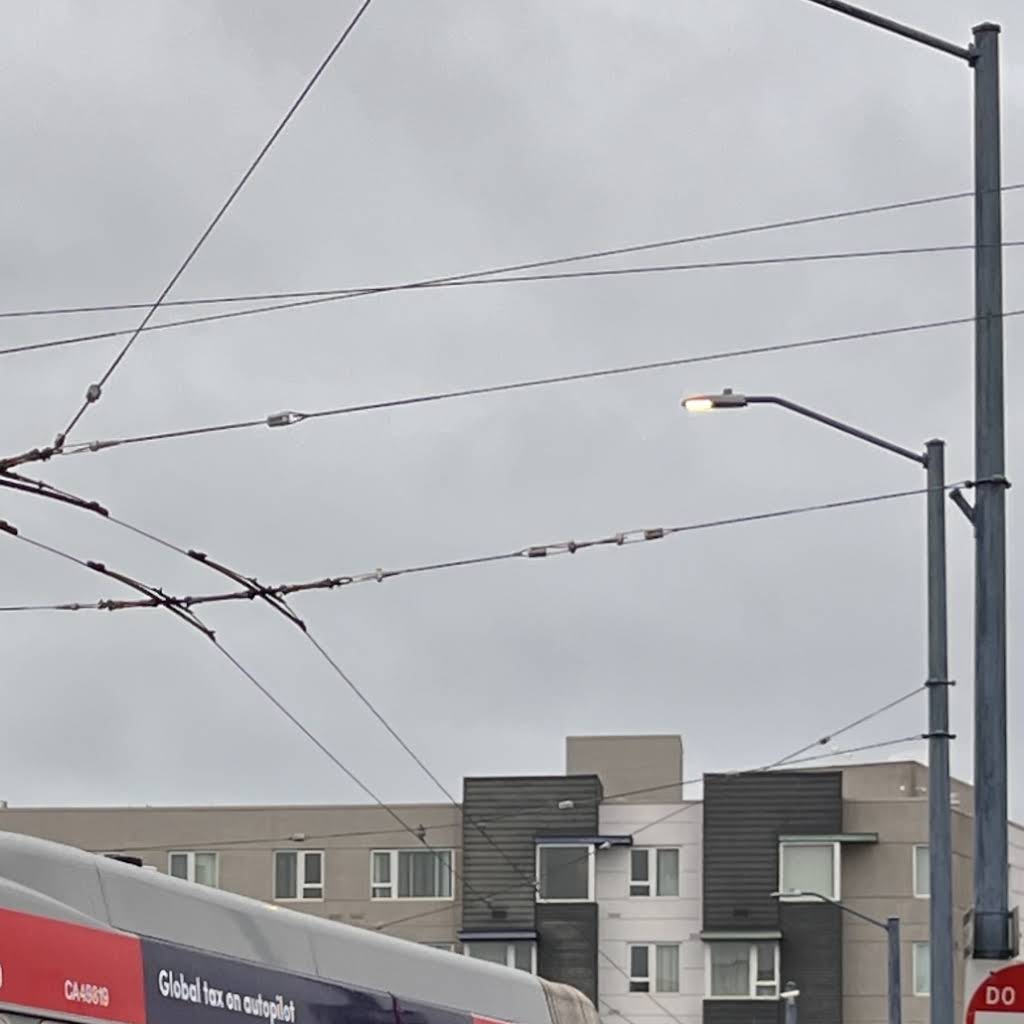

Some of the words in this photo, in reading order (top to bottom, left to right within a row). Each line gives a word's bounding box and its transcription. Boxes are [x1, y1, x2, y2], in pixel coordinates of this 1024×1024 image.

[158, 969, 202, 1003] Global
[203, 980, 225, 1008] tax
[226, 991, 242, 1012] on
[985, 986, 1016, 1006] DO
